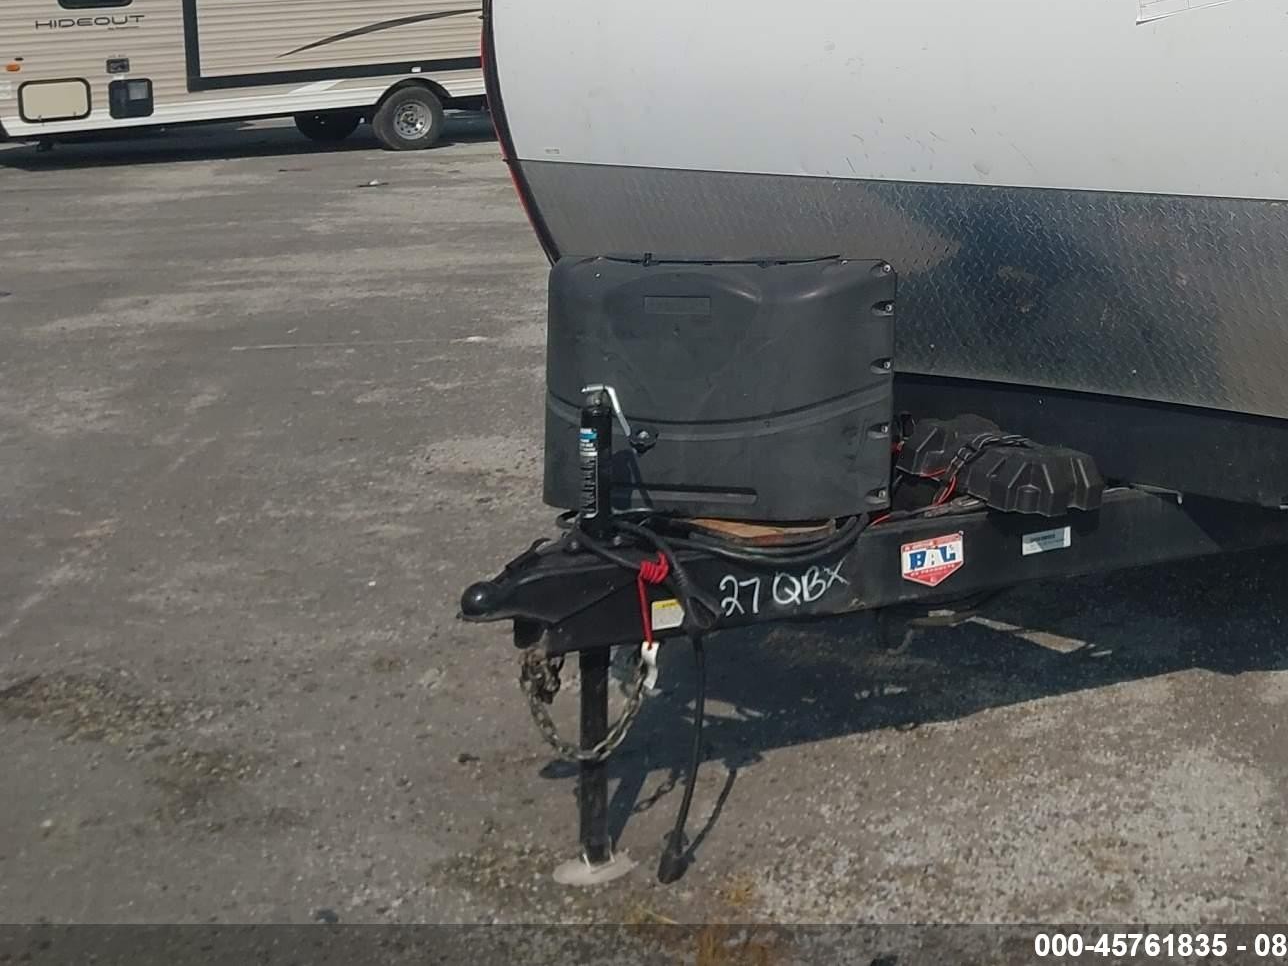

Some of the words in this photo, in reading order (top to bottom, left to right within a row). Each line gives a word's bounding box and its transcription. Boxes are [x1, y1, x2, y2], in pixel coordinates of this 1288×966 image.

[35, 15, 145, 30] HIDEOUT
[719, 574, 761, 617] 27
[772, 554, 850, 606] QBX
